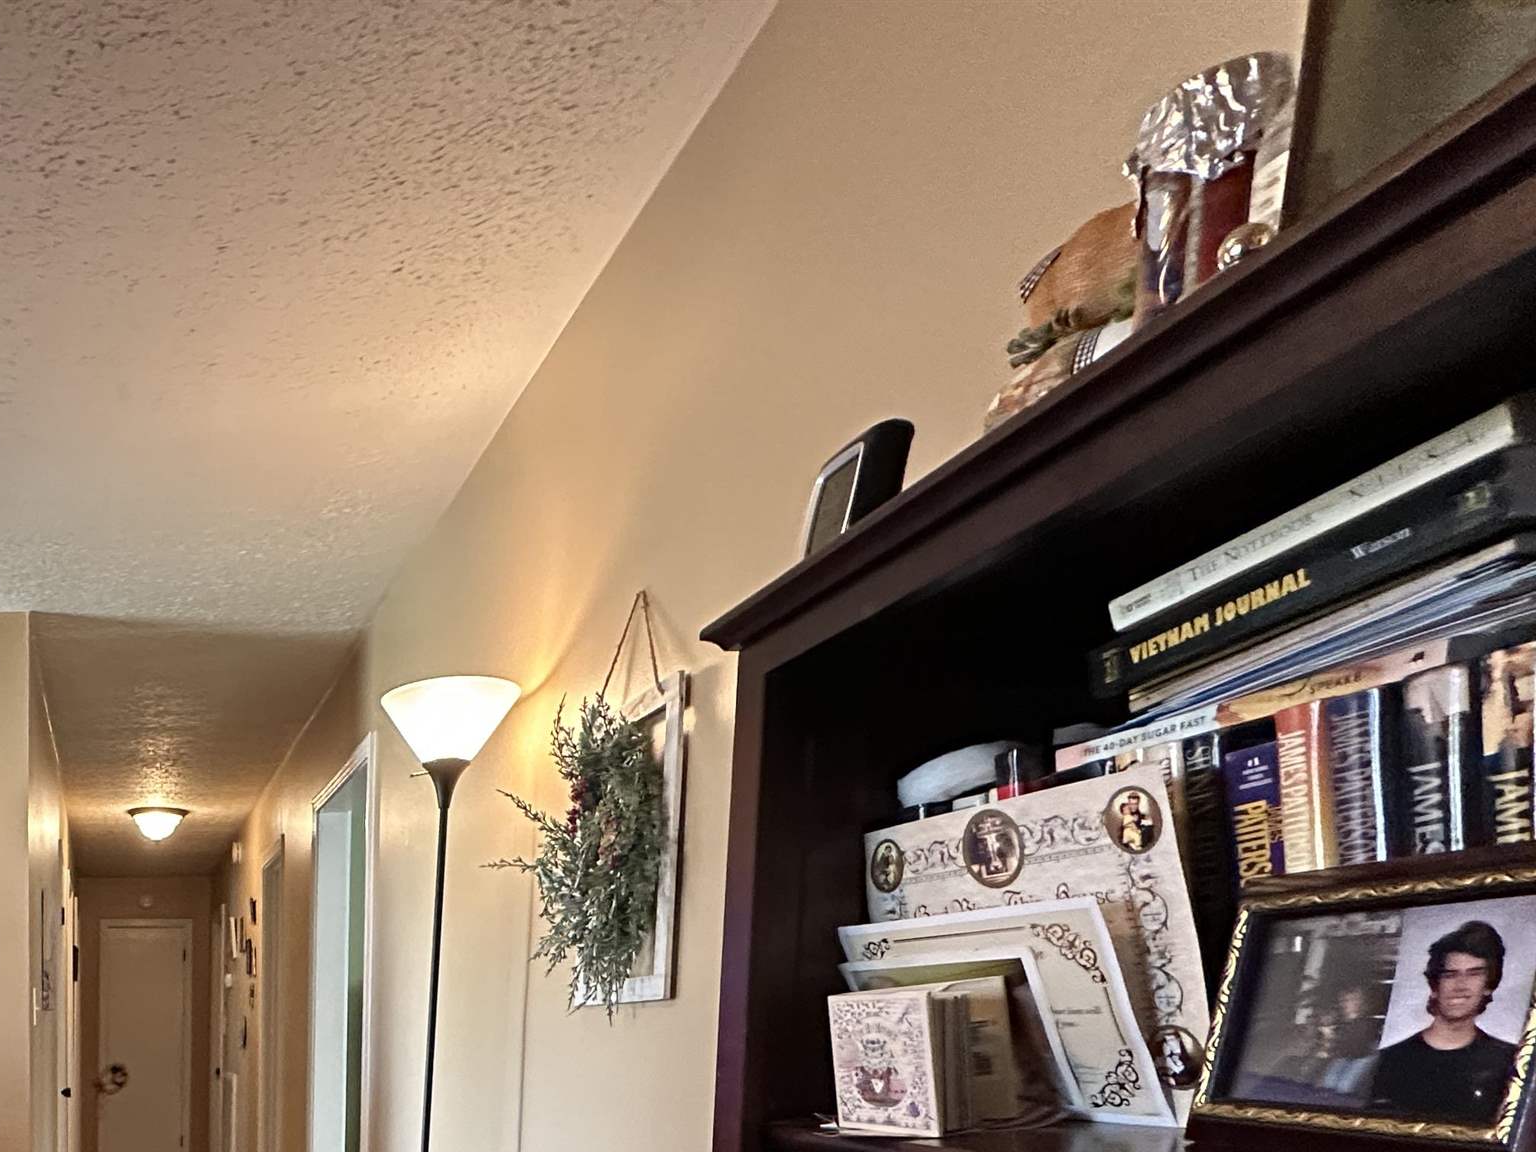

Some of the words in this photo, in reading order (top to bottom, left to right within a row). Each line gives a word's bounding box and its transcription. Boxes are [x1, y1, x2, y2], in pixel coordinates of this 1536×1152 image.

[1129, 618, 1211, 664] VIETNAM
[1215, 568, 1312, 627] JOURNAL
[1083, 744, 1101, 758] THE
[1103, 734, 1139, 752] 40-DAY
[1140, 724, 1178, 743] SUGAR
[1179, 716, 1207, 735] FAST
[1277, 730, 1307, 785] JAMES
